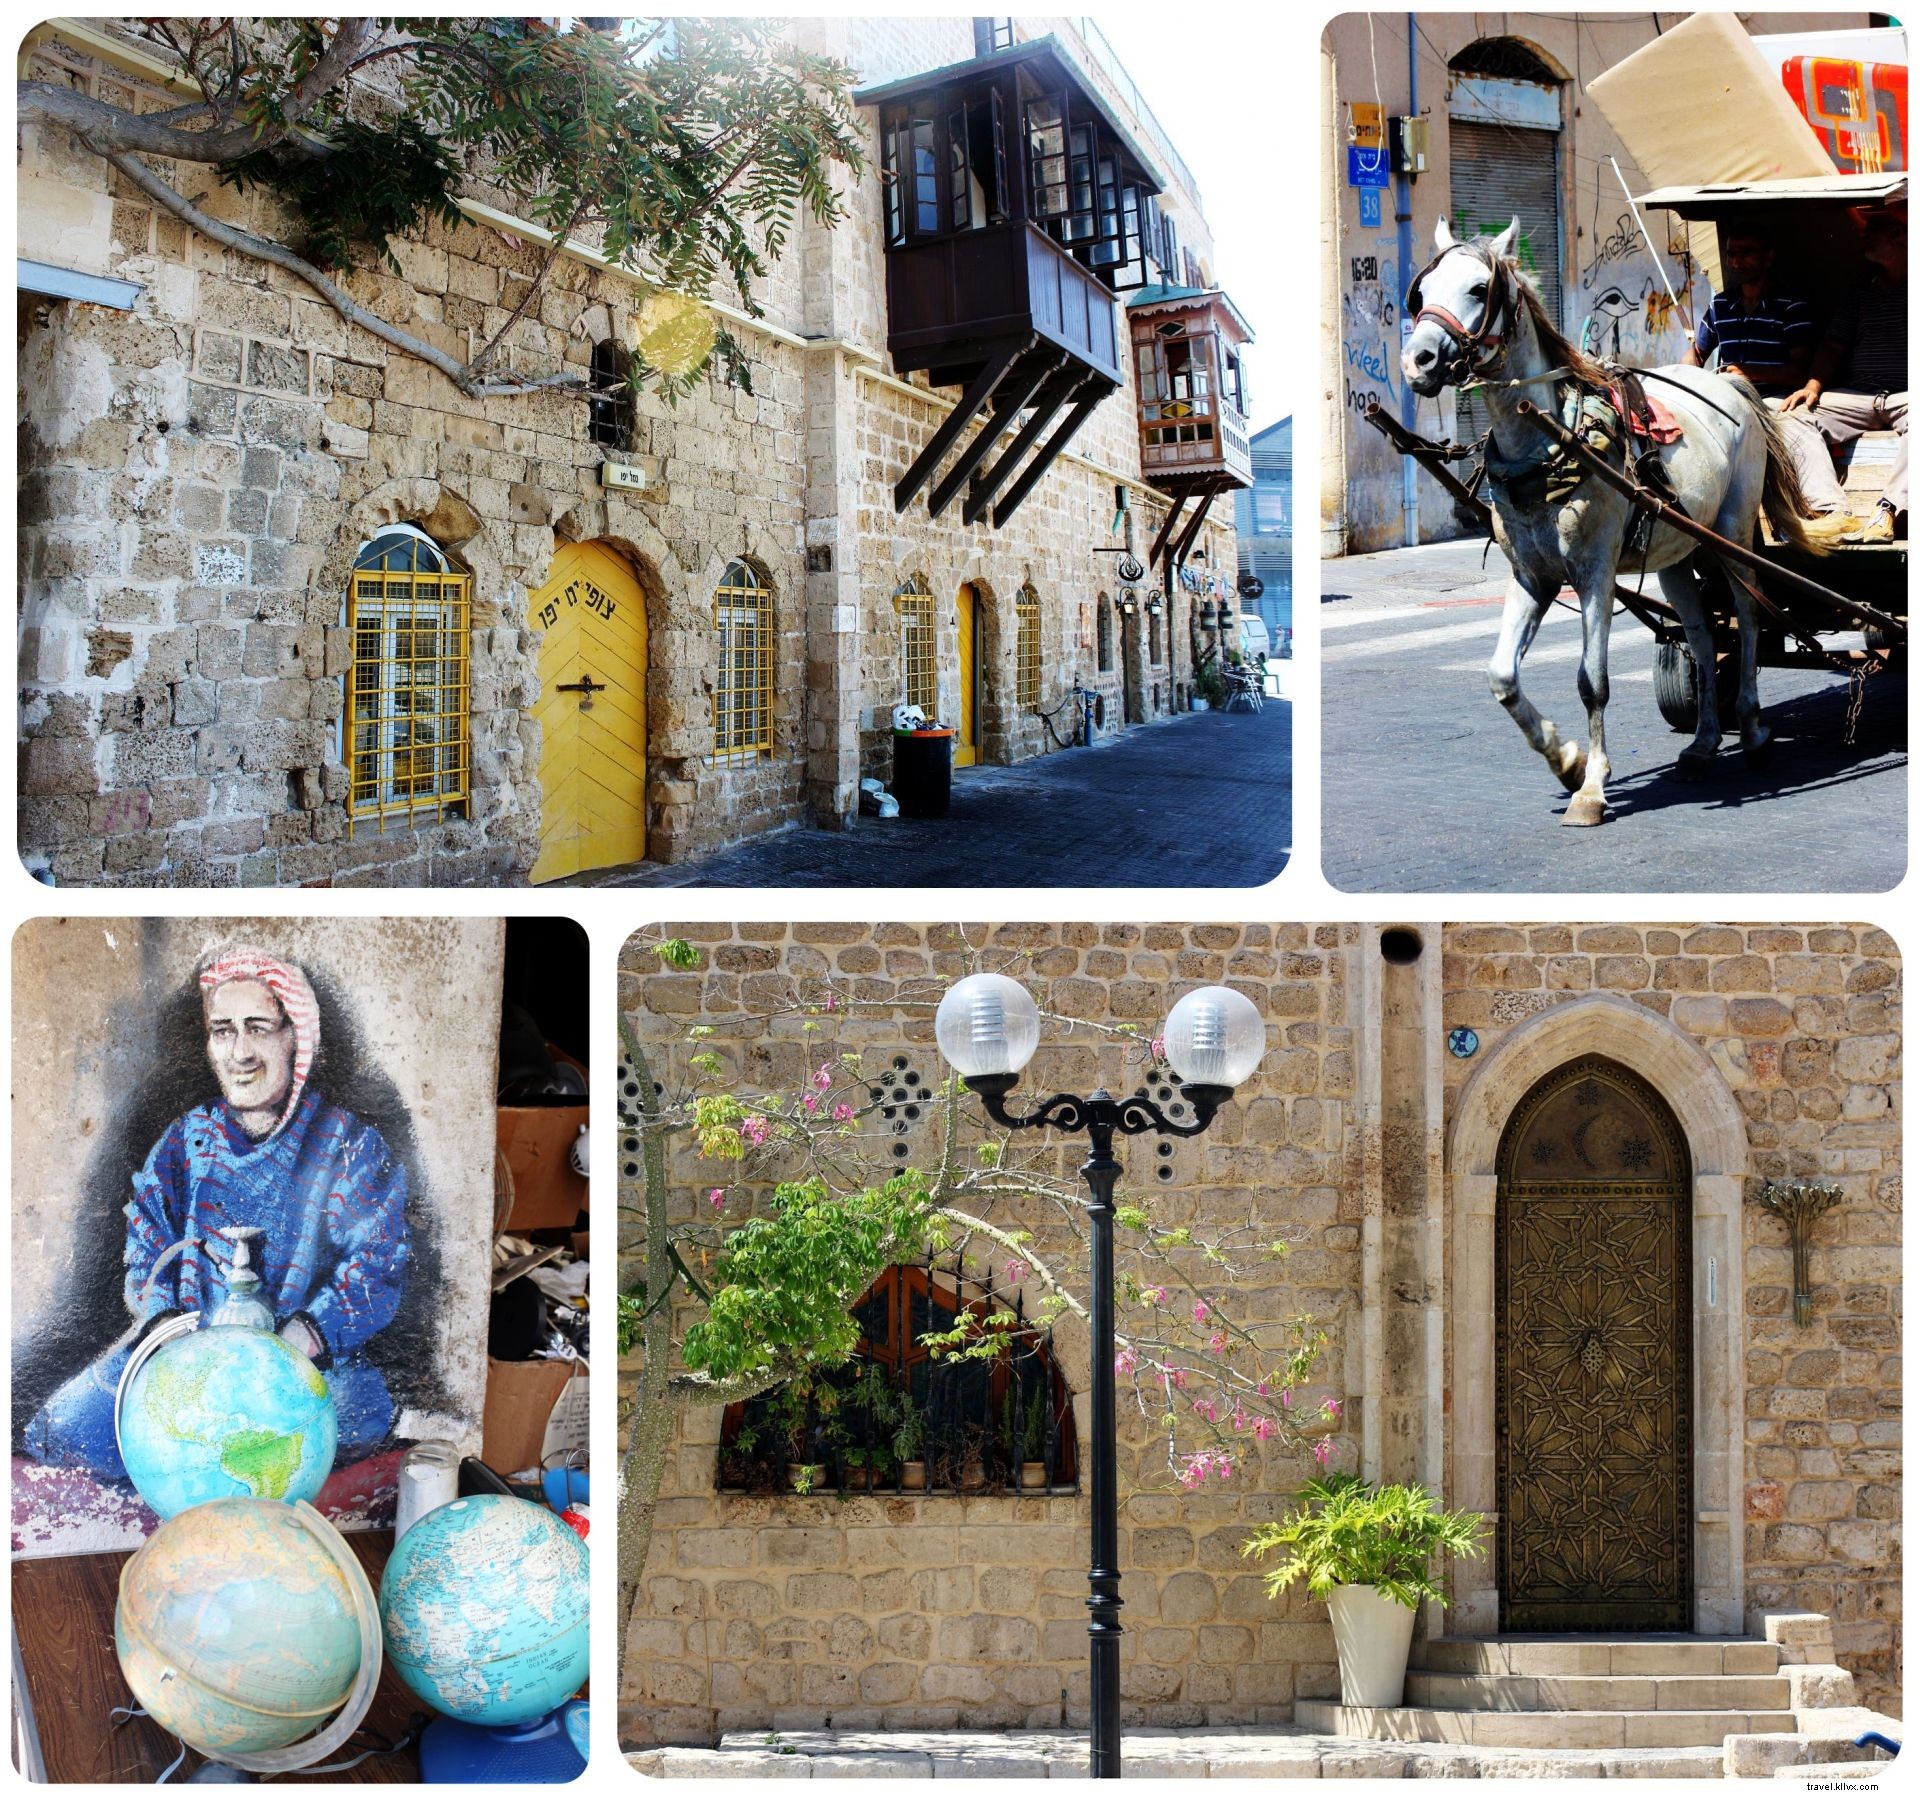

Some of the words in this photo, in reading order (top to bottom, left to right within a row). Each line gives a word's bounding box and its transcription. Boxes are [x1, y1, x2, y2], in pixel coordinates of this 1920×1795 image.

[1363, 196, 1378, 218] 38
[1351, 256, 1378, 281] 16:20
[1344, 341, 1398, 404] Weed
[620, 471, 629, 481] יפו
[538, 597, 560, 630] יפו
[585, 581, 617, 621] צופי
